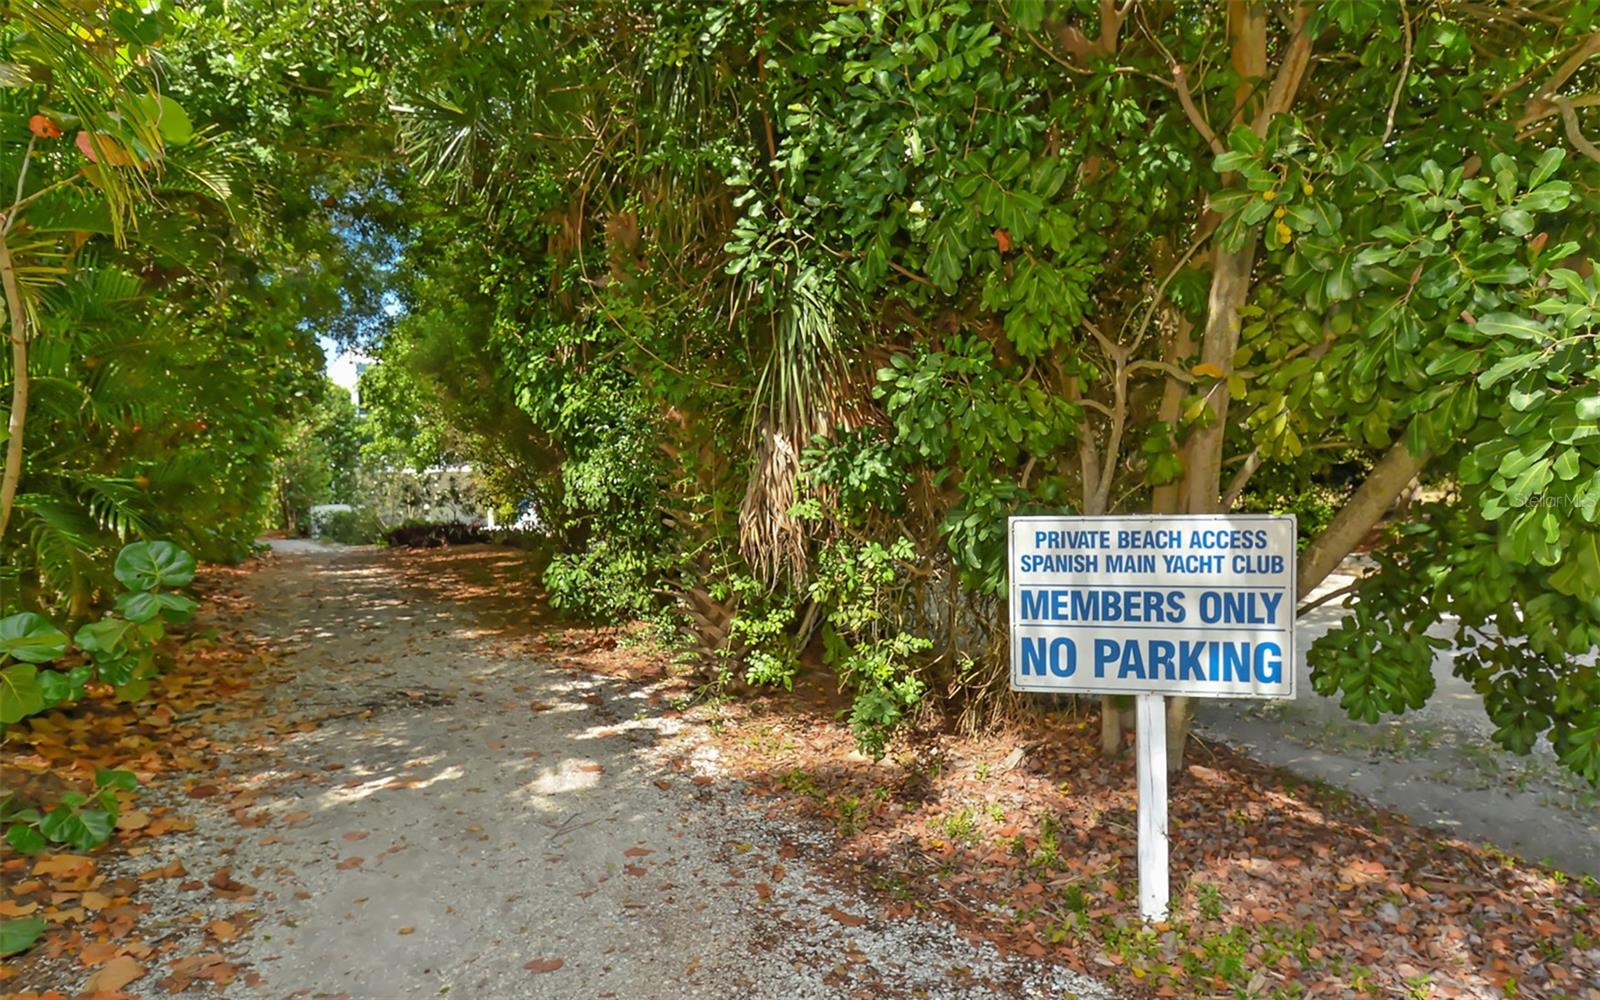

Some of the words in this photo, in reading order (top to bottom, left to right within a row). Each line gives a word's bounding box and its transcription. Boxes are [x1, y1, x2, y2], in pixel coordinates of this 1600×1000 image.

[1035, 530, 1110, 549] PRIVATE
[1118, 530, 1181, 549] BEACH
[1190, 530, 1267, 549] ACCESS
[1021, 555, 1098, 573] SPANISH
[1106, 555, 1155, 573] MAIN
[1162, 555, 1225, 573] YACHT
[1232, 555, 1284, 574] CLUB
[1021, 590, 1185, 623] MEMBERS
[1199, 591, 1282, 624] ONLY
[1021, 637, 1076, 677] NO
[1094, 638, 1282, 684] PARKING
